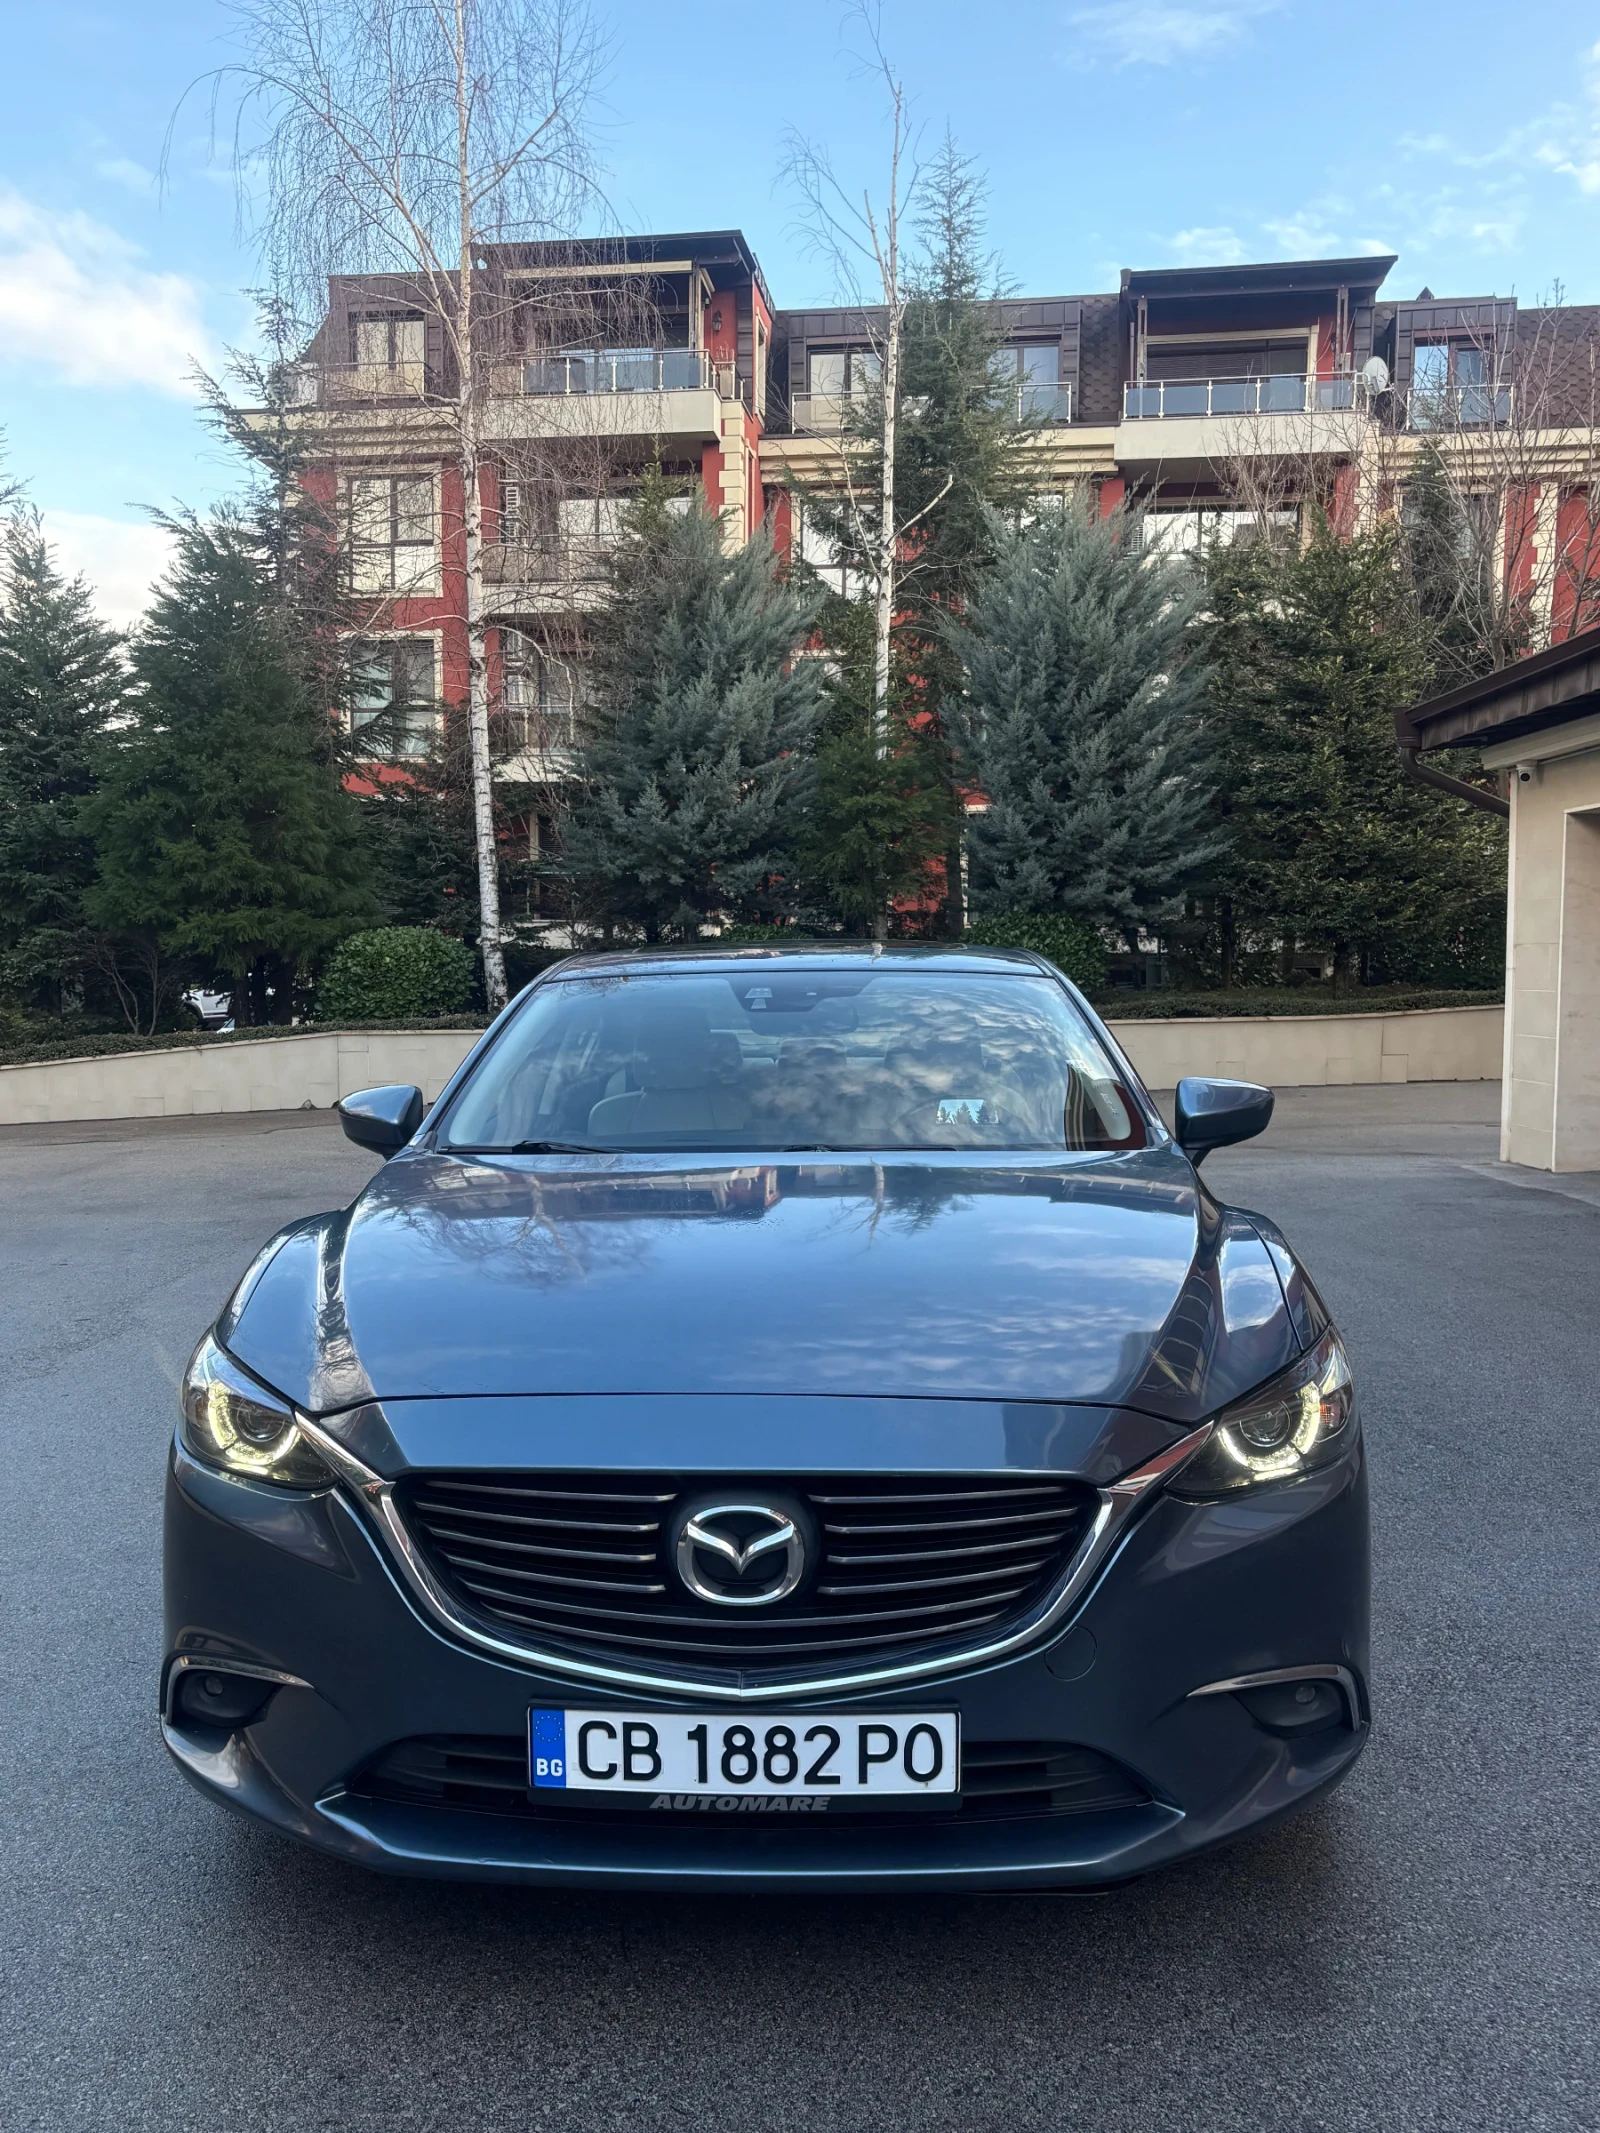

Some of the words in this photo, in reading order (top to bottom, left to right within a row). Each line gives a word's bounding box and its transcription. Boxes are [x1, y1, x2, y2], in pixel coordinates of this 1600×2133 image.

[578, 1720, 662, 1781] CB
[687, 1724, 841, 1784] 1882
[536, 1758, 563, 1777] BG
[650, 1794, 829, 1812] AUTOMARE
